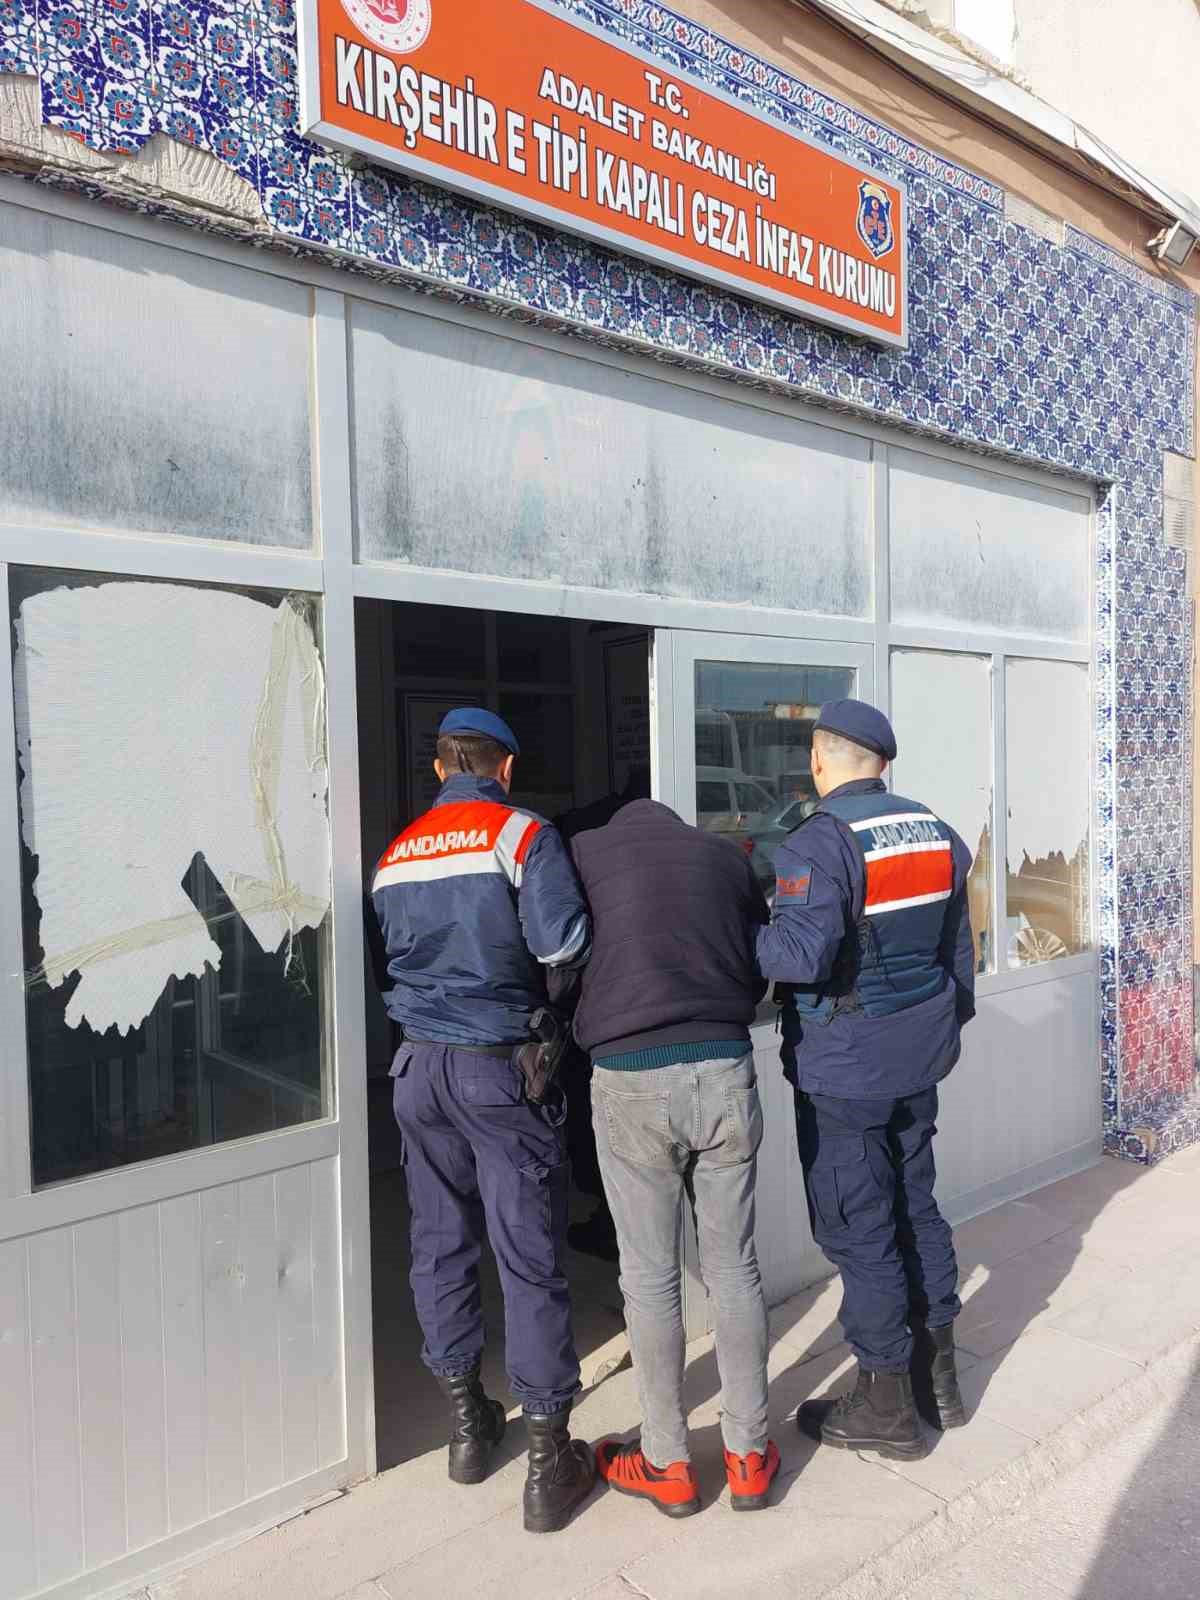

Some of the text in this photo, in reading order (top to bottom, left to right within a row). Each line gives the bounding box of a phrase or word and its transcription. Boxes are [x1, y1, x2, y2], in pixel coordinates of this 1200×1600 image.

[644, 70, 690, 119] T.C.
[538, 66, 776, 201] ADALET BAKANLIĞI
[335, 34, 897, 318] KIRŞEHİR E TİPİ KAPALI CEZA İNFAZ KURUMU
[387, 829, 488, 863] JANDARMA
[870, 820, 942, 850] JANDARMA
